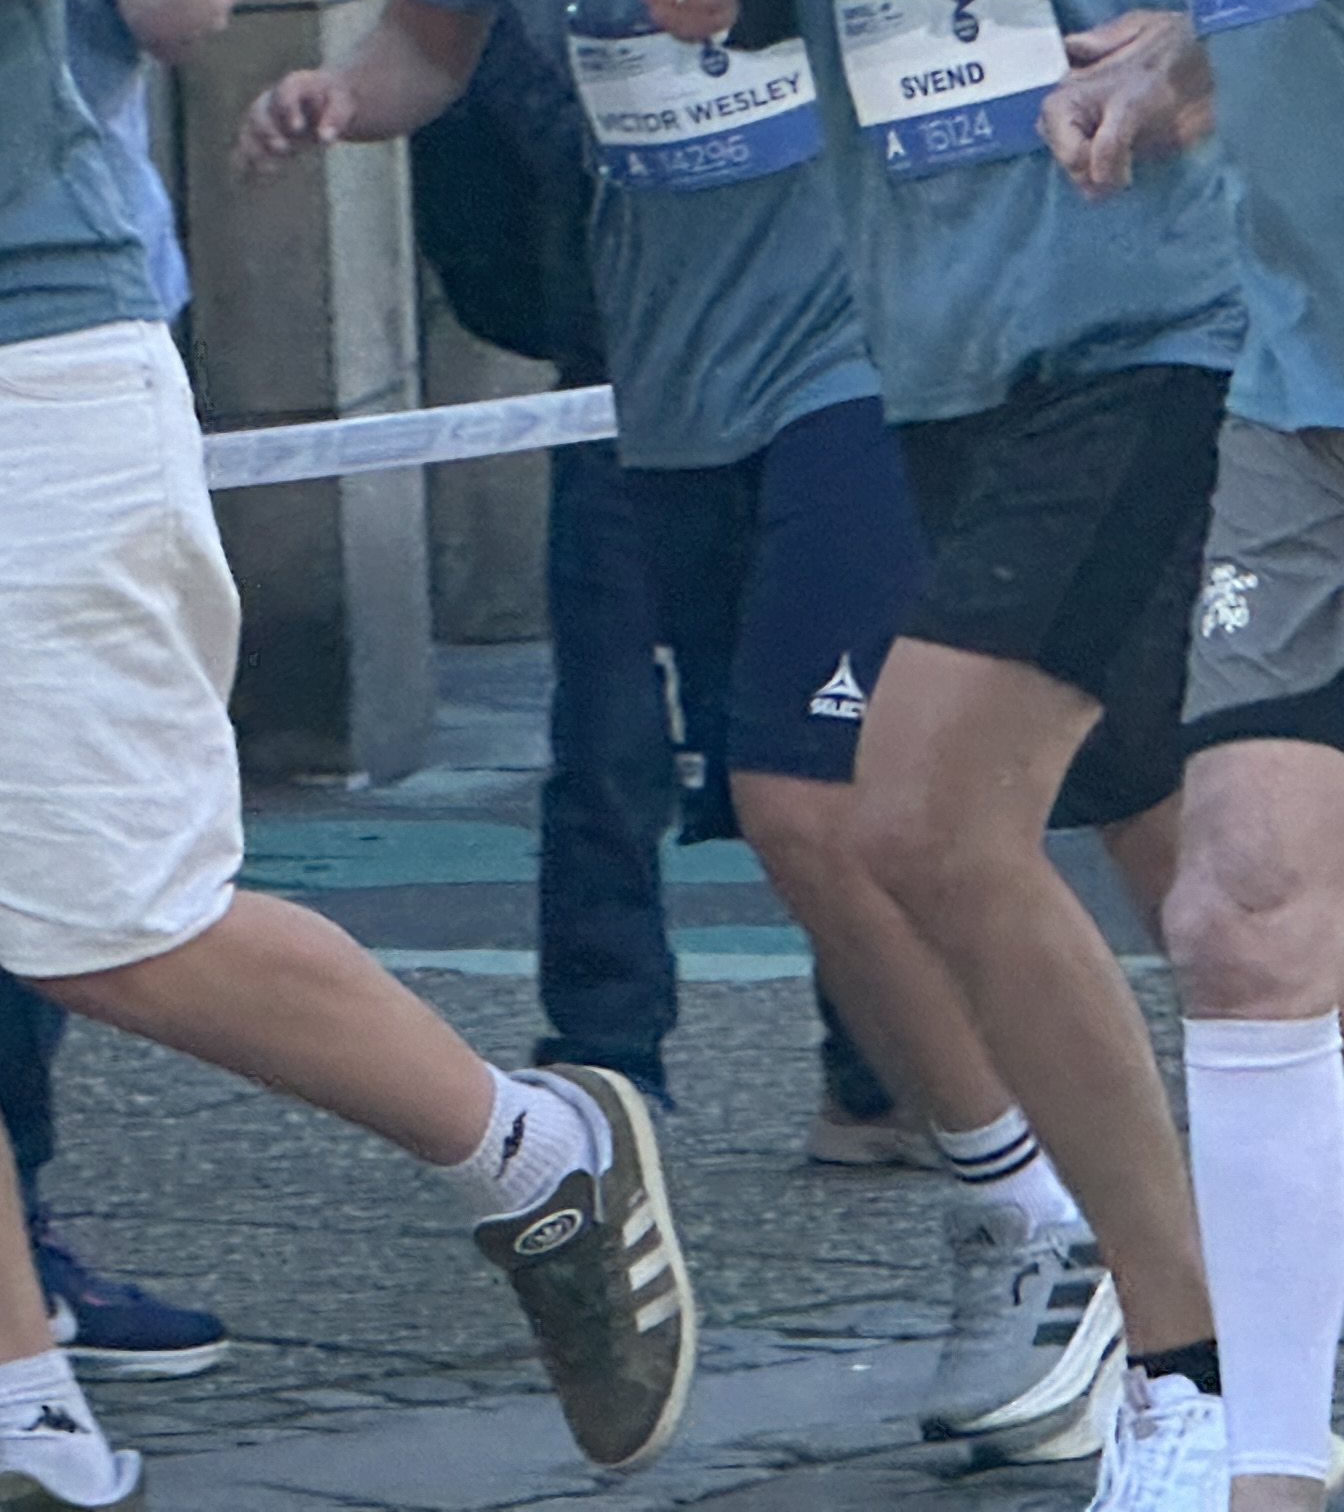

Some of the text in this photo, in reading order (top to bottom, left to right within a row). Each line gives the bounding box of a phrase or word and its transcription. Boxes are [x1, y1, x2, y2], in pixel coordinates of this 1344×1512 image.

[685, 72, 801, 125] WESLEY
[899, 61, 986, 100] SVEND
[886, 128, 908, 161] A
